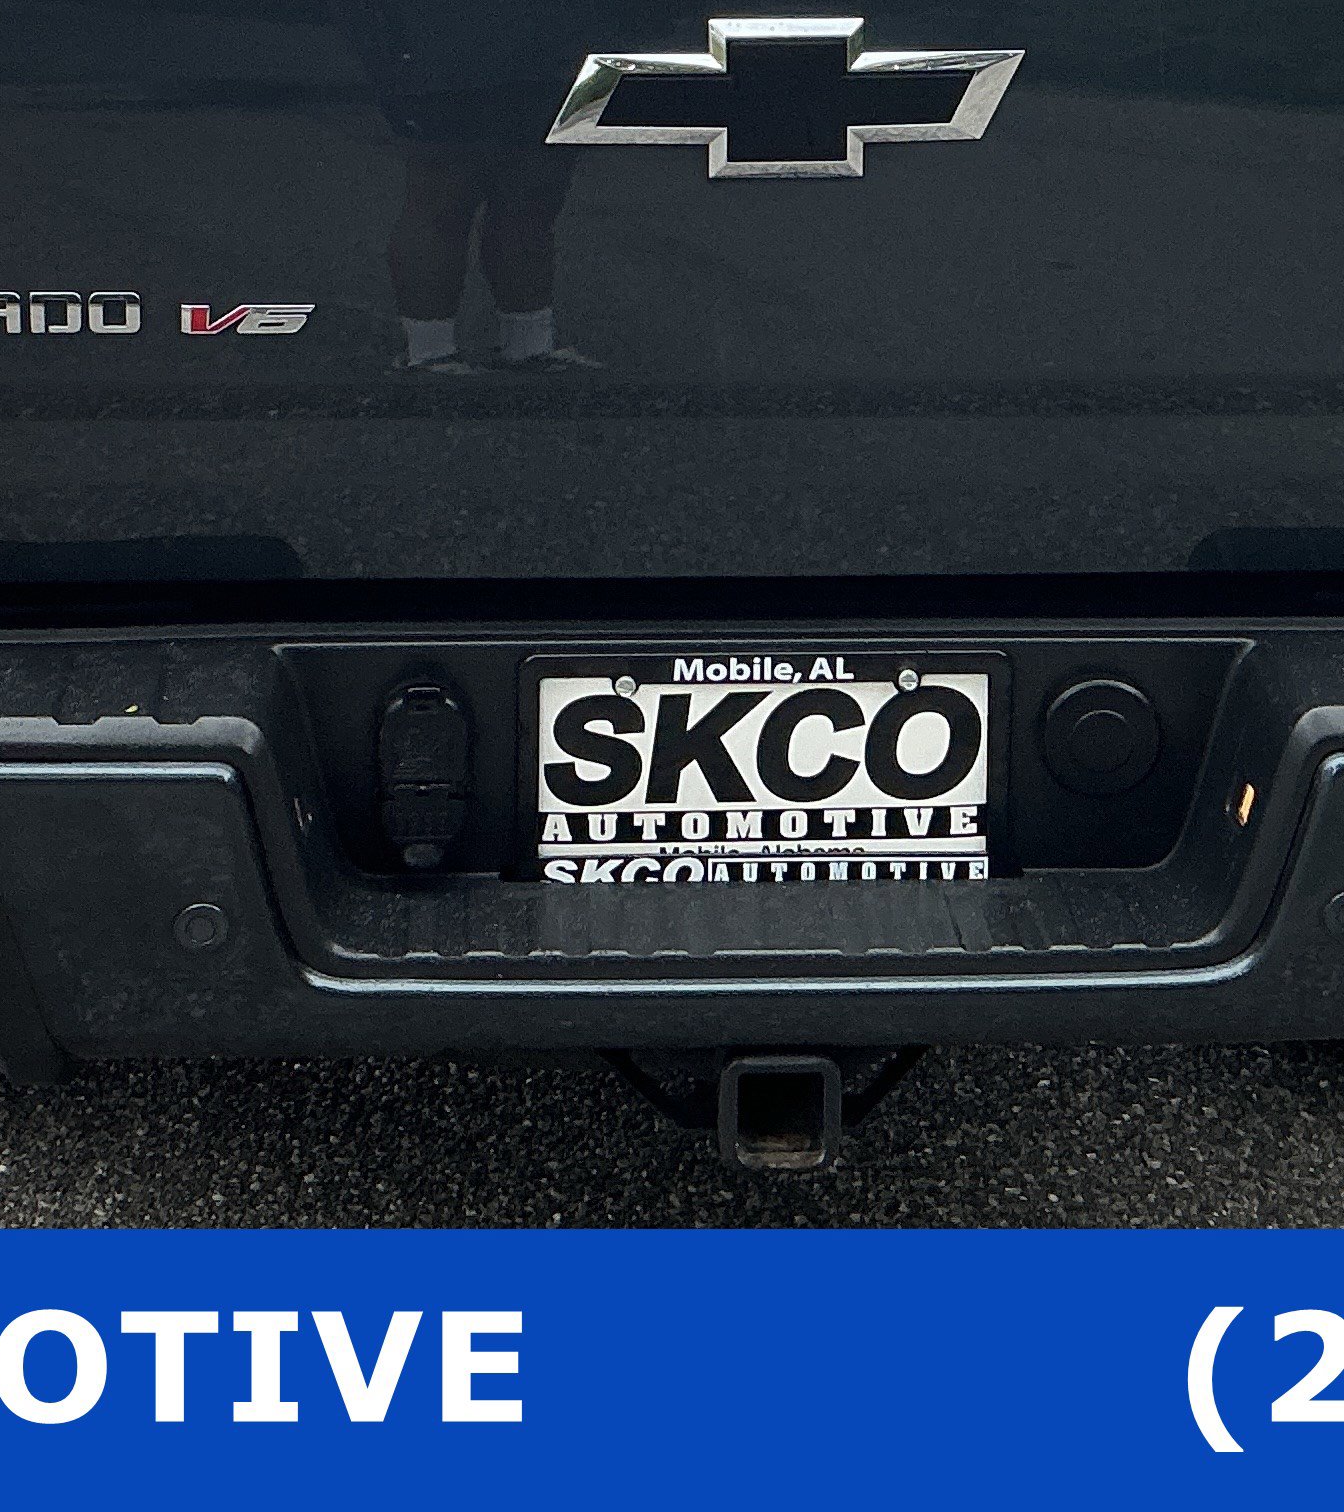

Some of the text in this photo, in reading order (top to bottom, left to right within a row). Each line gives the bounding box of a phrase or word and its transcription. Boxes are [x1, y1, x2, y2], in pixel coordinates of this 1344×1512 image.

[180, 303, 316, 336] V6
[672, 656, 855, 685] Mobile, AL
[543, 686, 982, 807] SKCO
[542, 808, 979, 842] AUTOMOTIVE
[543, 856, 985, 884] SKCO AUTOMOTIVE
